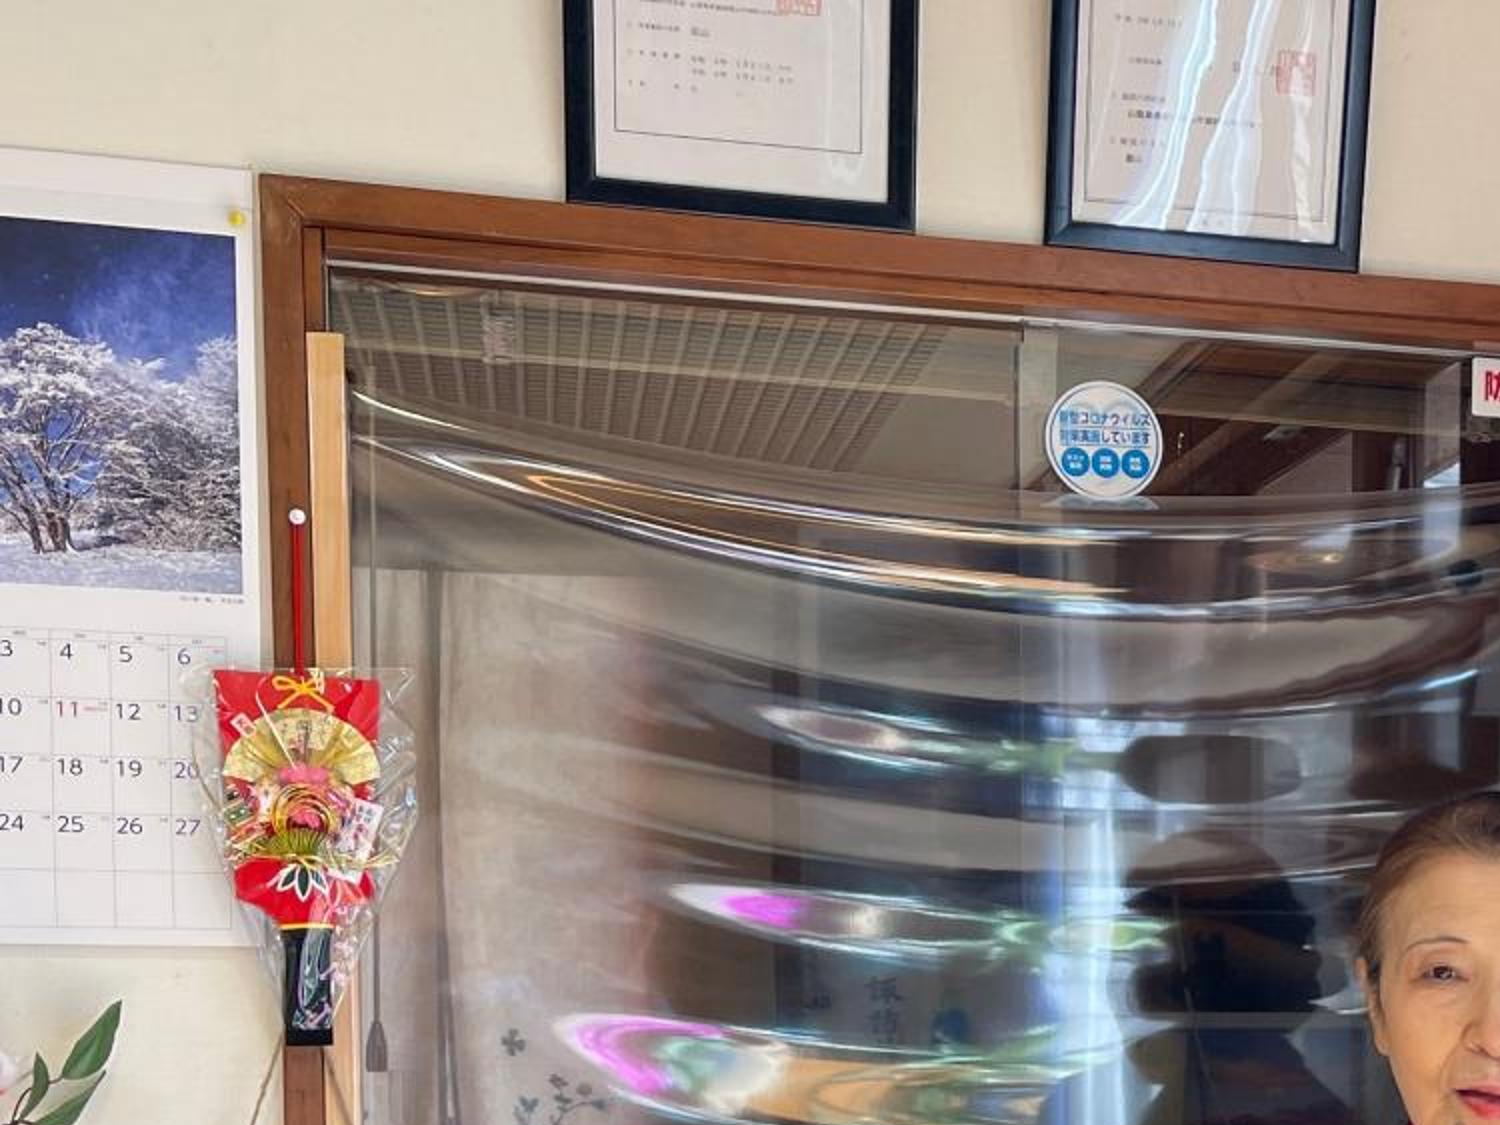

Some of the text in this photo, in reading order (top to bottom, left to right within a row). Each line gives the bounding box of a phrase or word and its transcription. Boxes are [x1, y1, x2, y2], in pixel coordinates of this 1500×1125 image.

[59, 643, 74, 660] 4
[119, 645, 133, 663] 5
[177, 648, 191, 666] 6
[56, 701, 79, 718] 11
[116, 703, 142, 721] 12
[174, 705, 200, 723] 13
[58, 757, 83, 777] 18
[117, 759, 143, 779] 19
[175, 761, 200, 780] 20
[0, 813, 200, 837] 24 25 26 27
